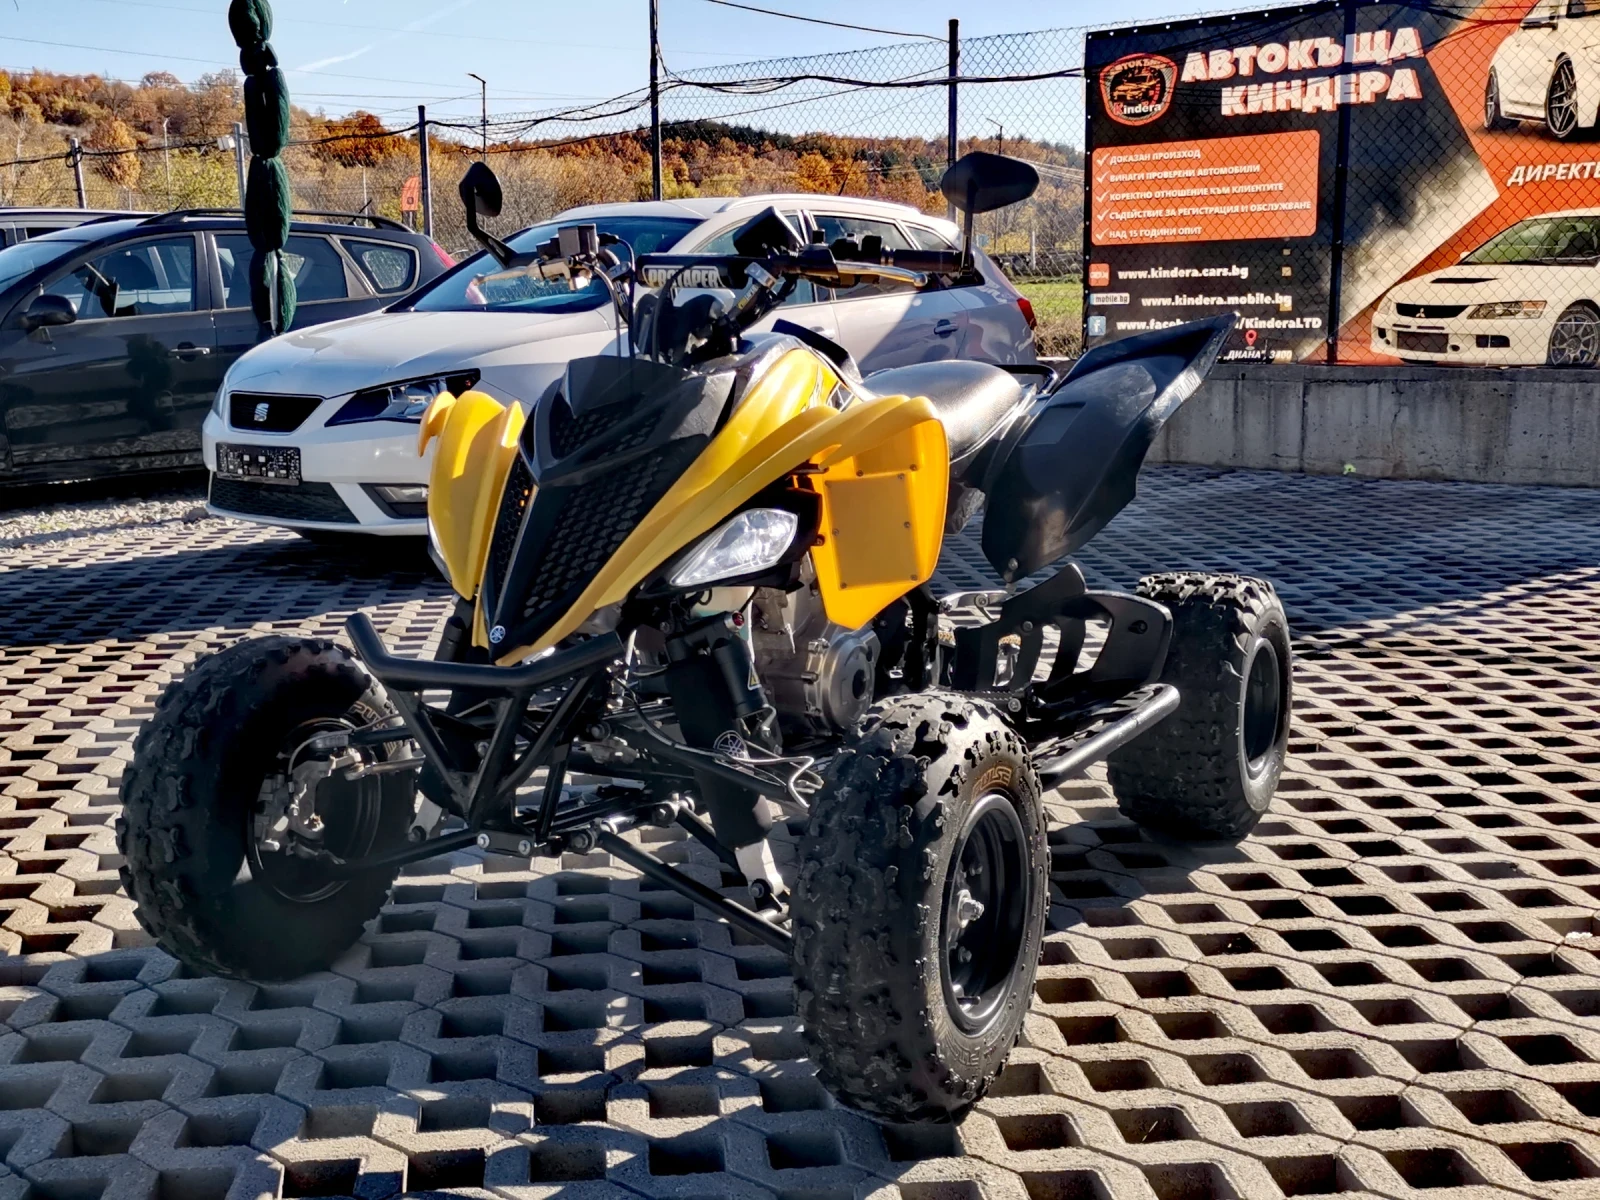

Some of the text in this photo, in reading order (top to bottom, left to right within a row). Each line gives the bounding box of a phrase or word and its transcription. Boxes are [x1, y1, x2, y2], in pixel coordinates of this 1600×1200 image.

[1181, 27, 1424, 82] АВТОКЪЩА
[1221, 68, 1422, 116] КИНДЕРА
[1113, 101, 1161, 115] Kindera
[1110, 150, 1201, 165] ДОКАЗАН ПРОИЗХОД
[1110, 164, 1260, 182] ВИНАГИ ПРОВЕРЕНИ АВТОМОБИЛИ
[1110, 182, 1284, 201] КОРЕКТНО ОТНОШЕНИЕ КЪМ КЛИЕНТИТЕ
[1109, 209, 1163, 221] СЪДЕЙСТВИЕ
[1165, 208, 1176, 217] ЗА
[1178, 205, 1239, 216] РЕГИСТРАЦИЯ
[1250, 201, 1312, 212] ОБСЛУЖВАНЕ
[1109, 230, 1127, 239] НАД
[1139, 228, 1176, 238] ГОДИНИ
[1178, 226, 1203, 235] ОПИТ
[1117, 265, 1249, 279] www.kindera.cars.bg
[1141, 292, 1292, 307] www.kindera.mobile.bg
